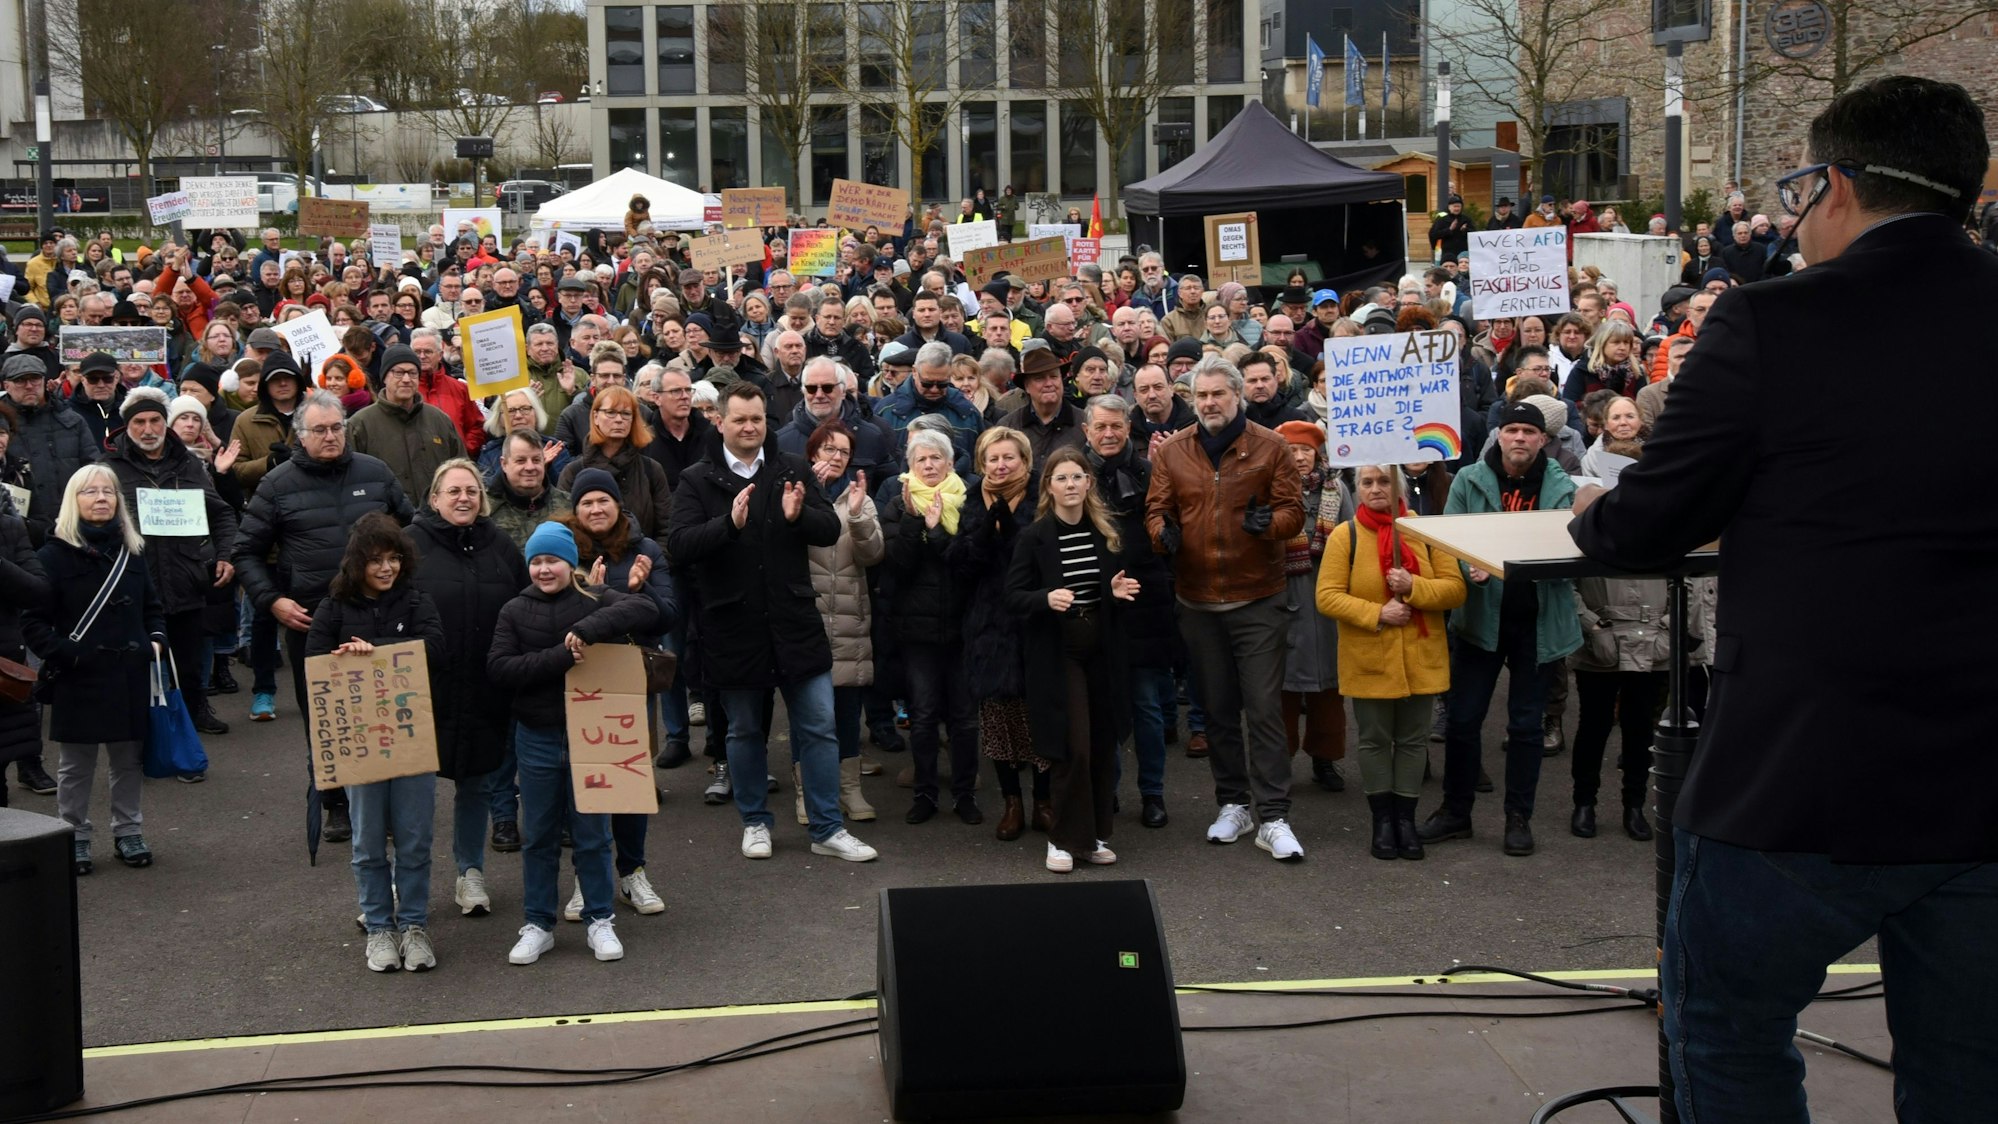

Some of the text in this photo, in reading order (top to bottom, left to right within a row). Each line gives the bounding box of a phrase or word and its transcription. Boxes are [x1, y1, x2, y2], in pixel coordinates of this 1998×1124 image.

[1771, 5, 1825, 33] 32
[839, 184, 861, 195] WER
[149, 196, 188, 211] Fremden
[836, 195, 900, 212] DEMOKRATIE
[153, 208, 191, 224] Freunden
[845, 214, 859, 223] DER
[872, 211, 896, 220] WACHT
[1478, 231, 1565, 248] WER AFD
[1001, 259, 1024, 269] STATT
[1499, 251, 1536, 264] SÄT
[1021, 260, 1067, 276] MENSCHEN
[1498, 263, 1540, 275] WIRD
[1472, 275, 1562, 296] FASCHISMUS
[1500, 296, 1560, 313] ERNTEN
[291, 324, 313, 337] OMAS
[294, 333, 320, 347] GEGEN
[297, 341, 326, 358] RECHTS
[1332, 330, 1457, 368] WENN AFD
[1332, 362, 1455, 388] DIE ANTWORT IST,
[1331, 379, 1450, 402] WIE DUMM WAR
[1331, 400, 1423, 420] DANN DIE
[1336, 419, 1395, 438] FRAGE
[392, 651, 418, 738] Lieber
[329, 661, 352, 757] als rechte
[368, 659, 395, 759] Rechte für
[312, 681, 337, 783] Menschen!
